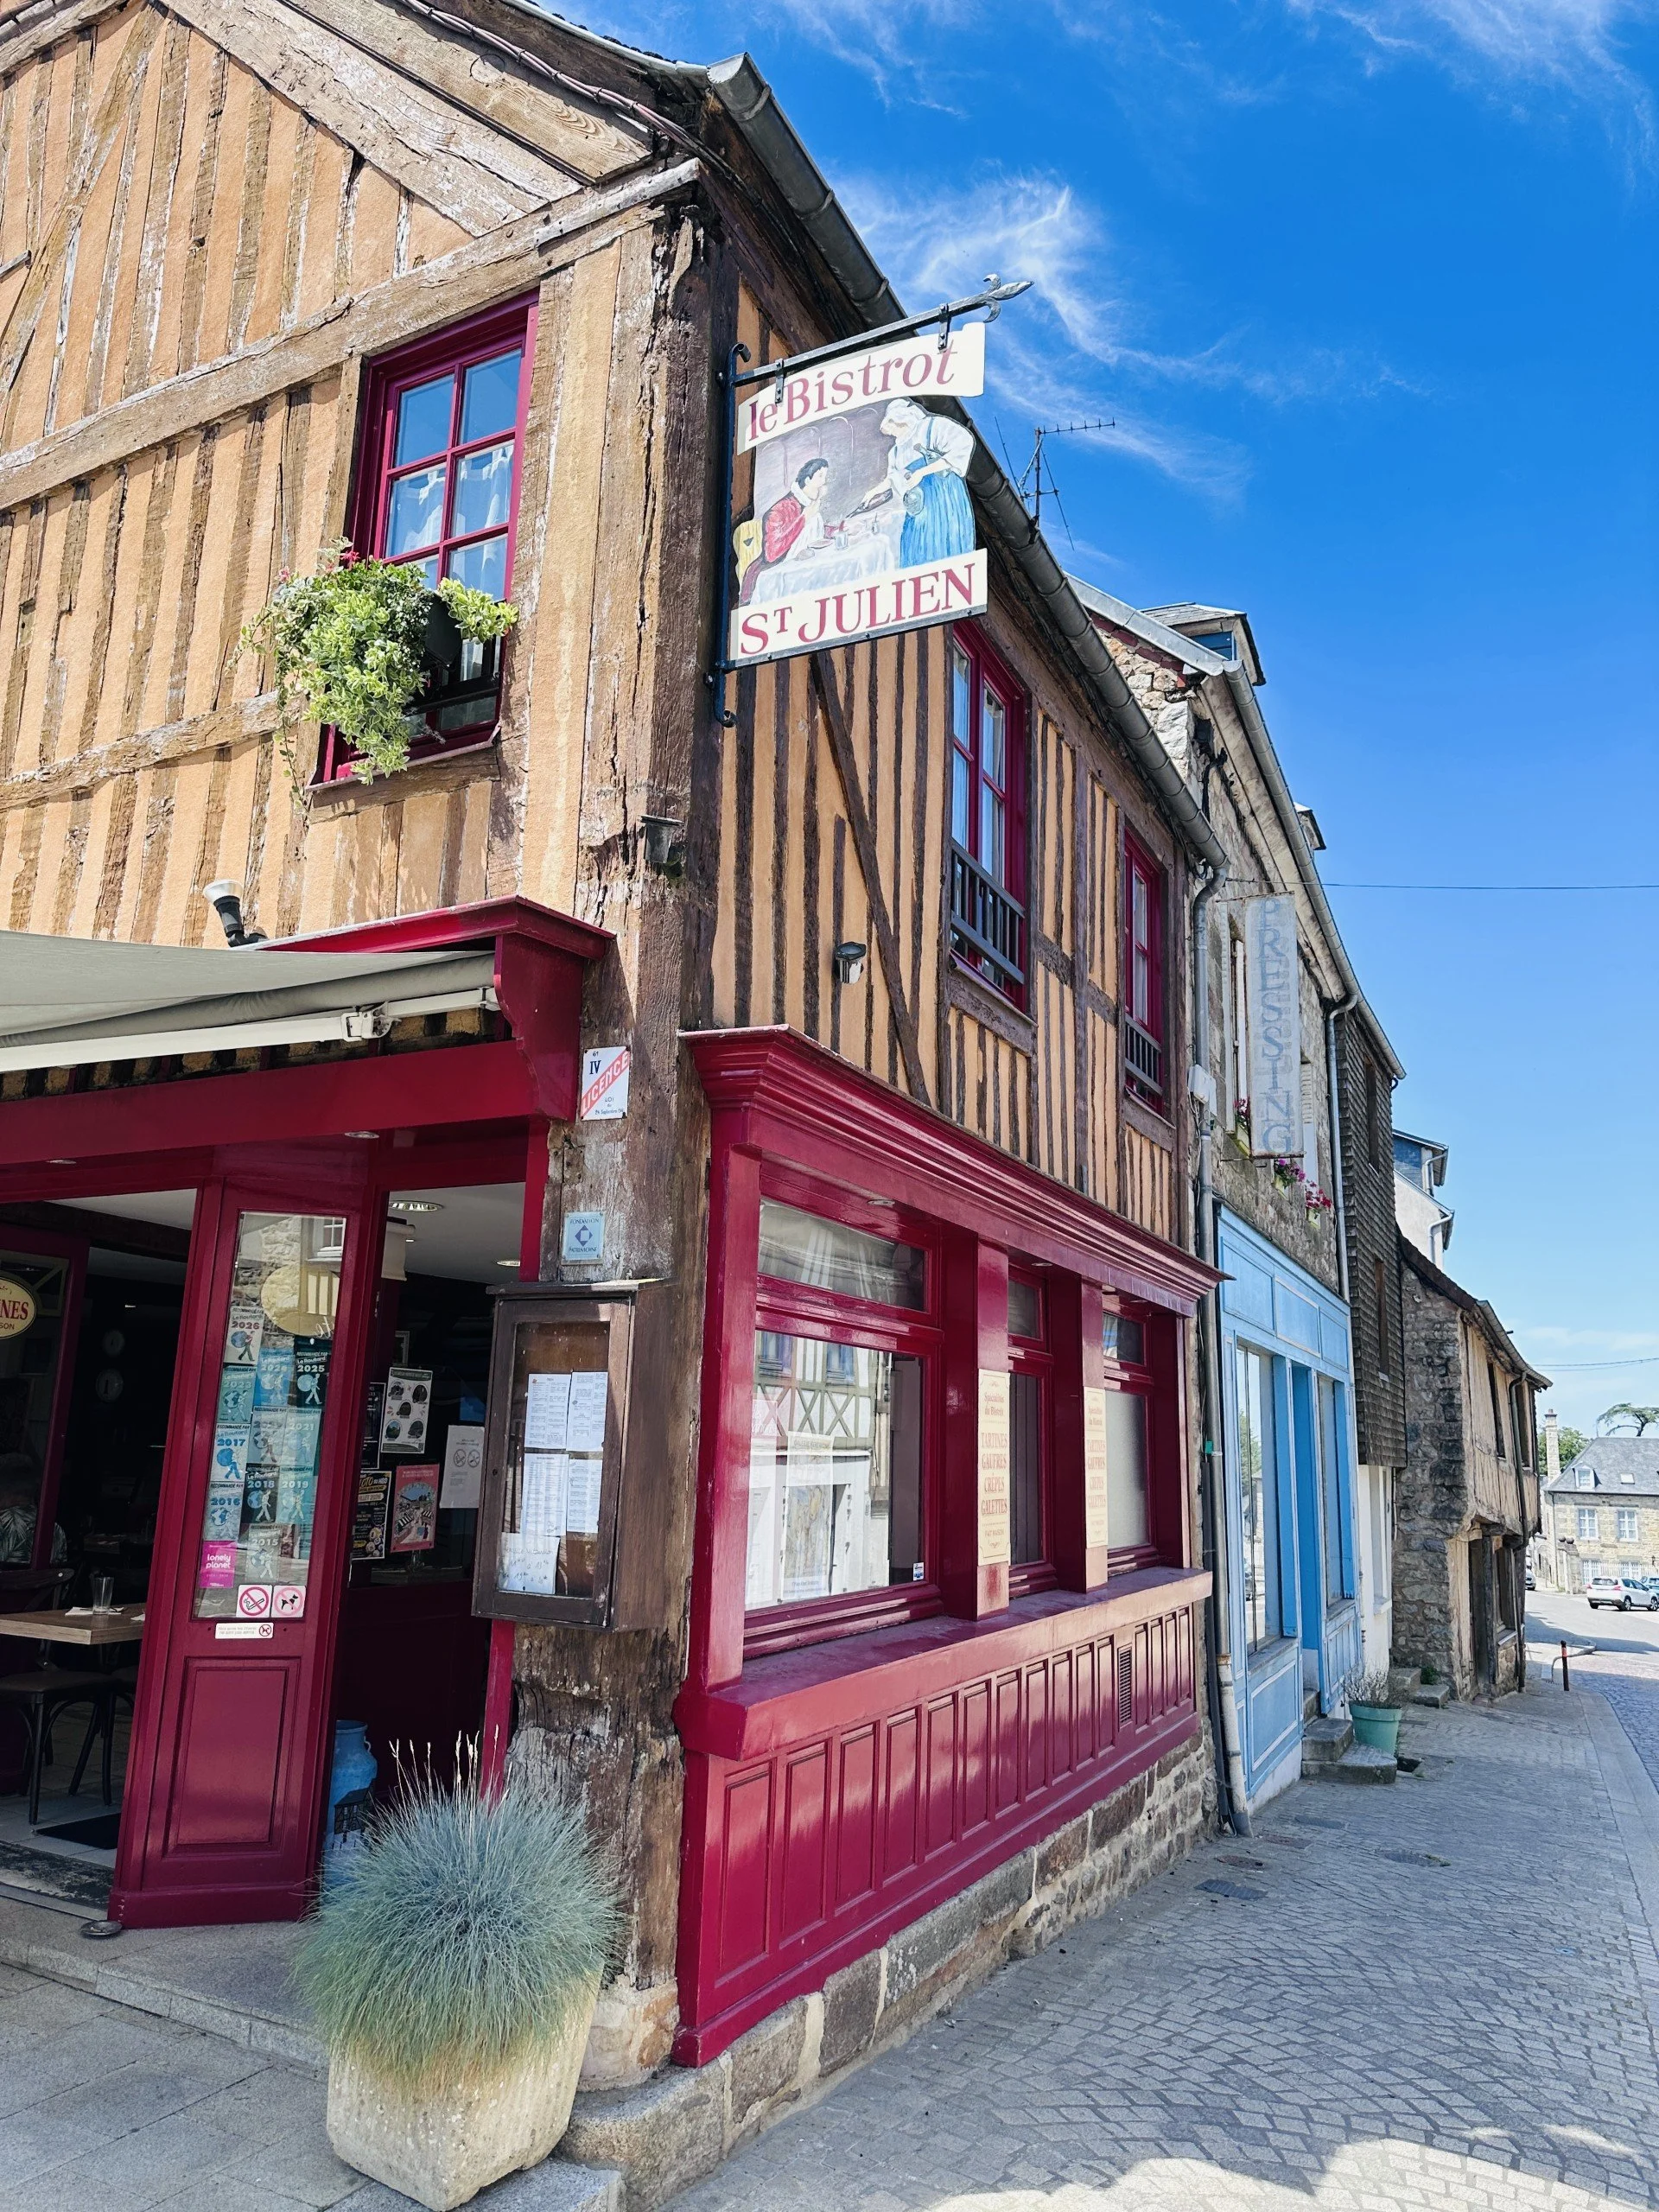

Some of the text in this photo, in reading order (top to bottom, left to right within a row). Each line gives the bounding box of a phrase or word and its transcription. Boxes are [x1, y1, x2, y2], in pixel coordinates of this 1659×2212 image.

[748, 339, 957, 442] le Bistrot
[798, 563, 976, 644] JULIEN
[1258, 897, 1293, 1154] PRESSING
[589, 1060, 601, 1074] IV
[582, 1052, 630, 1116] LICENCE
[0, 1300, 29, 1319] NES
[232, 1321, 259, 1330] 2026
[982, 1433, 1007, 1448] TARTINES
[982, 1453, 1007, 1469] GAUFRES
[981, 1498, 1007, 1516] GALETTES
[207, 1554, 231, 1563] lonely
